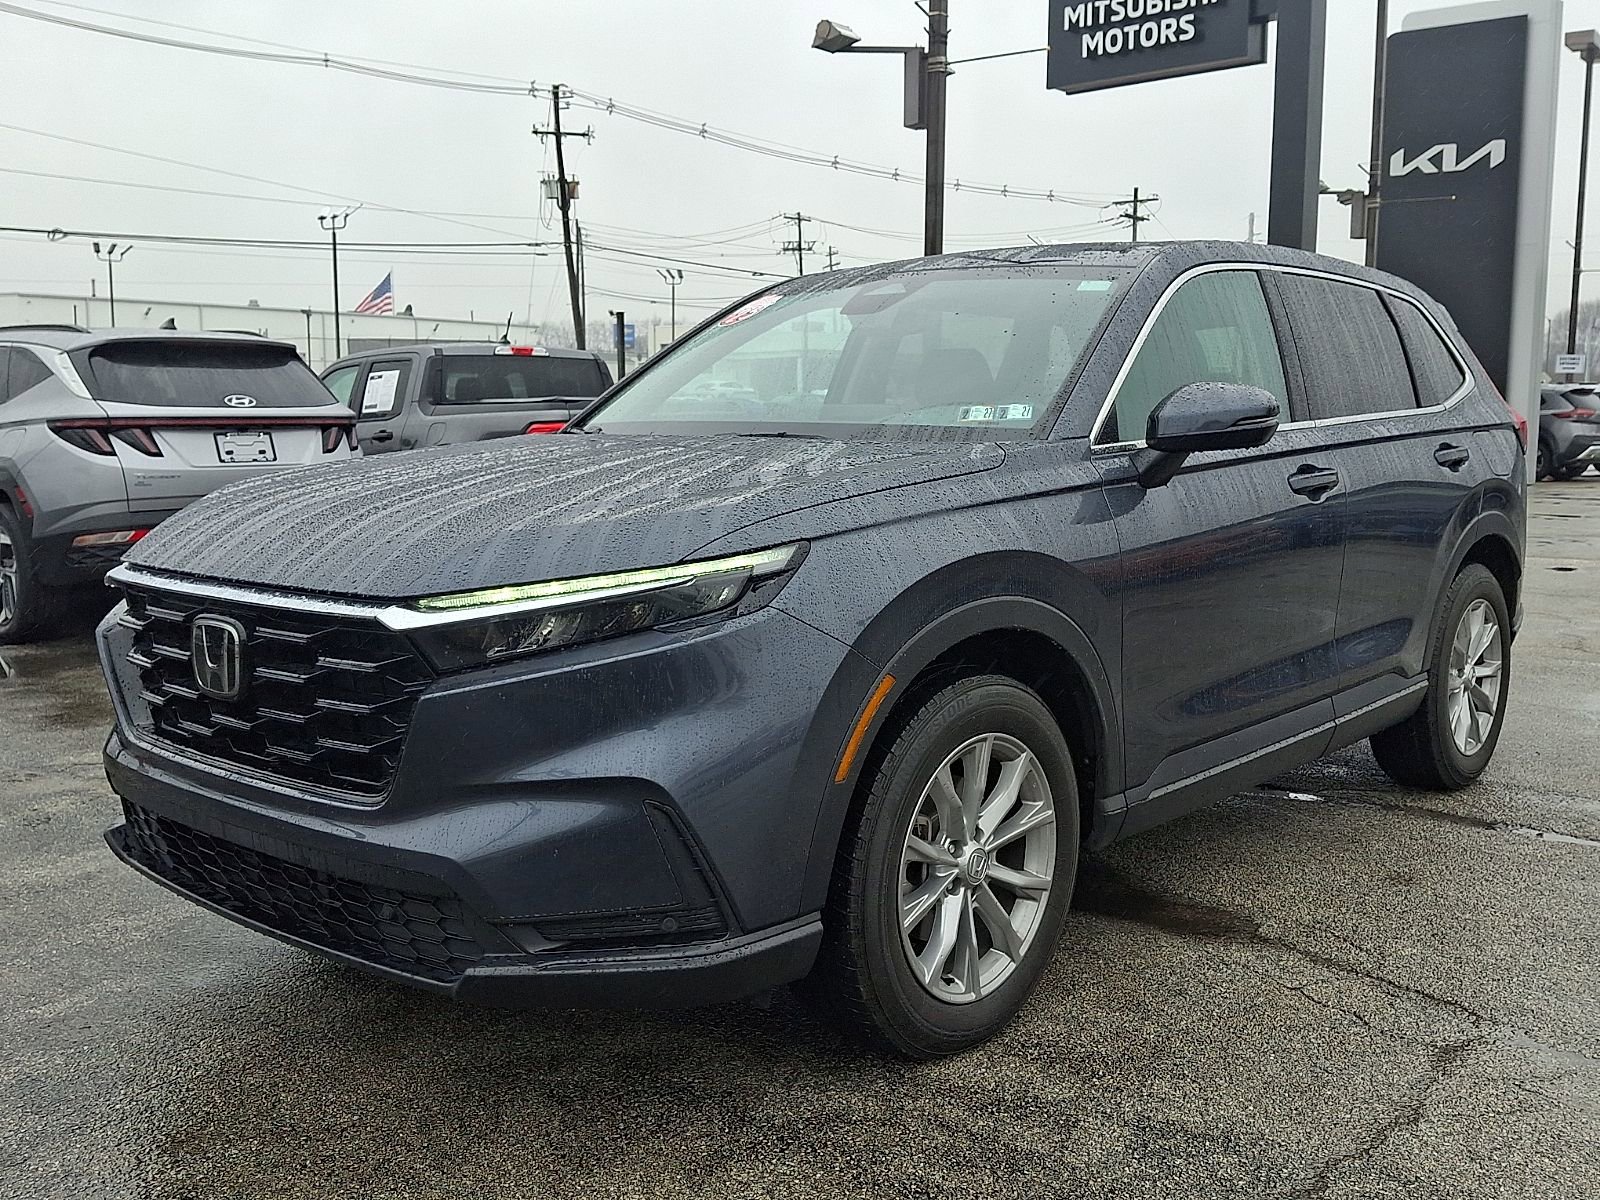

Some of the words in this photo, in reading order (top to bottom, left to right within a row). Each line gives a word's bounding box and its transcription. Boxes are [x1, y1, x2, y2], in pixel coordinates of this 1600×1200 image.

[1063, 0, 1218, 31] MITSUB
[1081, 13, 1196, 59] MOTORS
[983, 407, 993, 419] 27
[1021, 405, 1031, 417] 27
